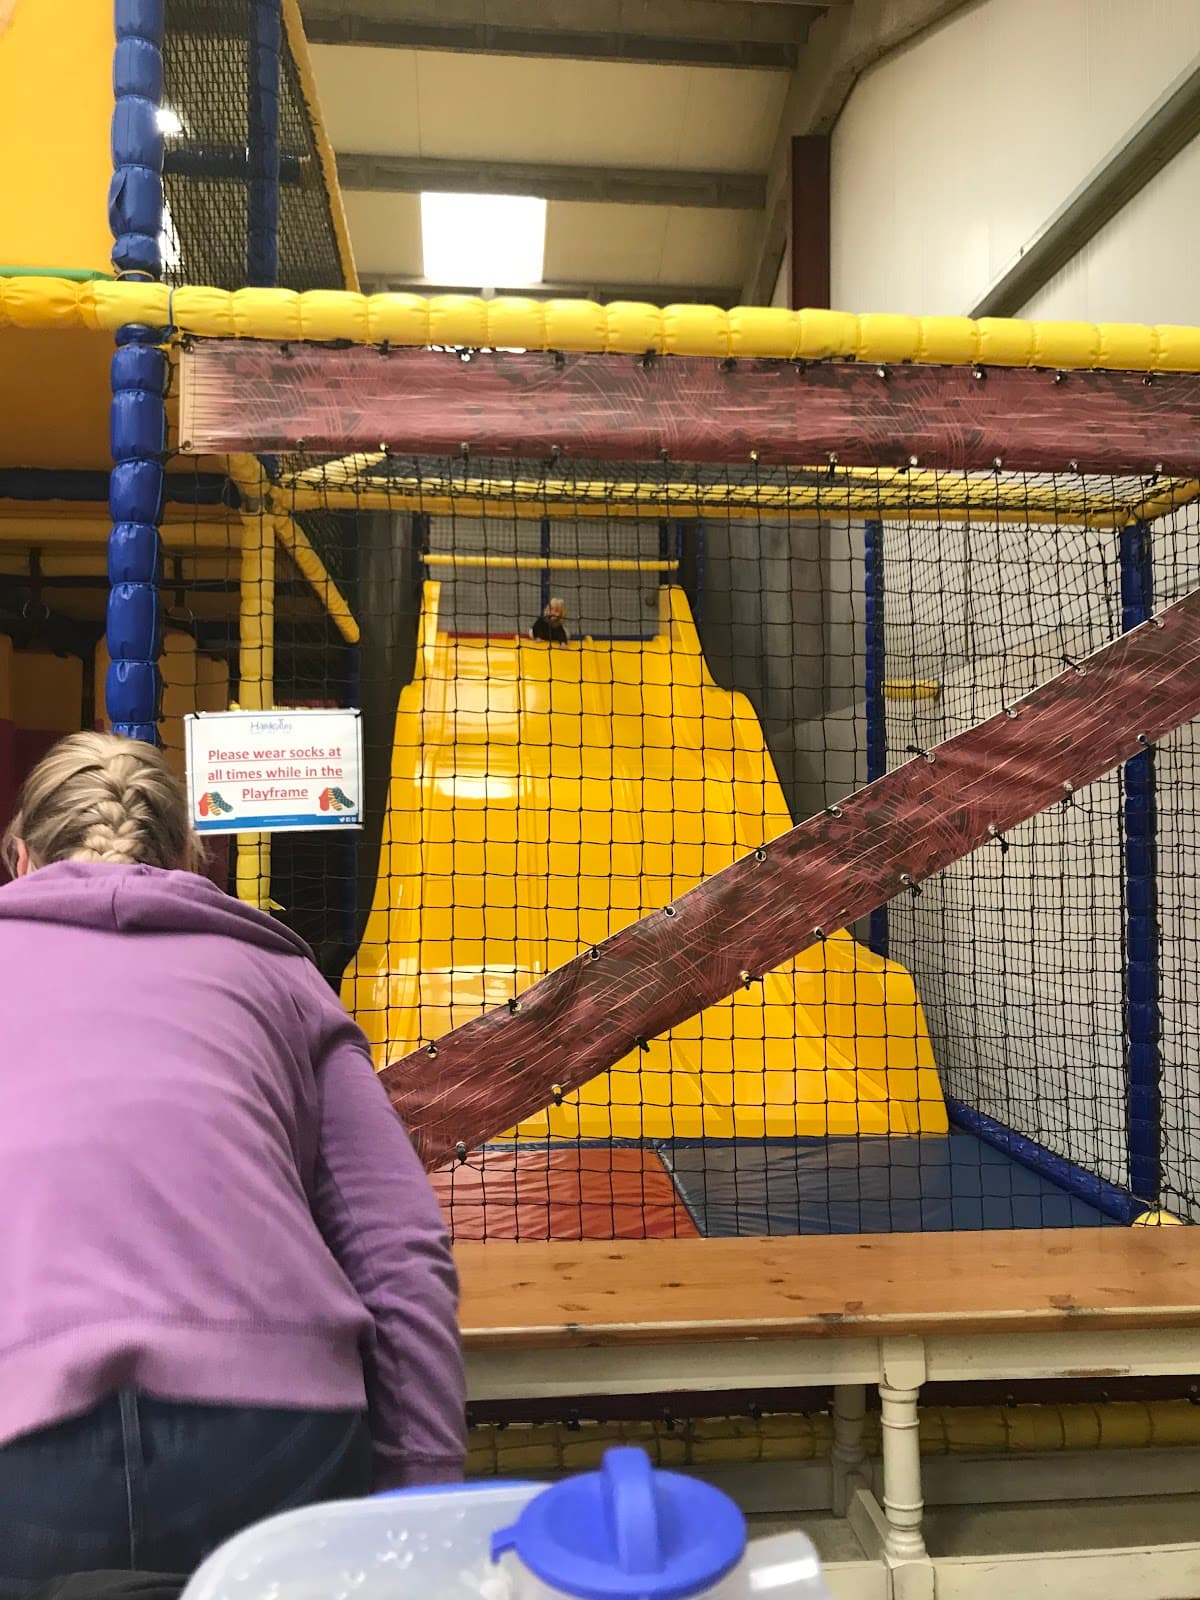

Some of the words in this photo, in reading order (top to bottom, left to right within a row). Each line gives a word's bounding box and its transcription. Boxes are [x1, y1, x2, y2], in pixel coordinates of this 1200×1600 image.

[208, 749, 249, 760] Please
[253, 749, 285, 759] wear
[290, 746, 324, 758] socks
[329, 747, 341, 757] at
[208, 769, 222, 781] all
[226, 768, 262, 779] times
[266, 766, 301, 778] while
[306, 766, 317, 777] in
[321, 765, 343, 776] the
[242, 787, 308, 800] Playframe
